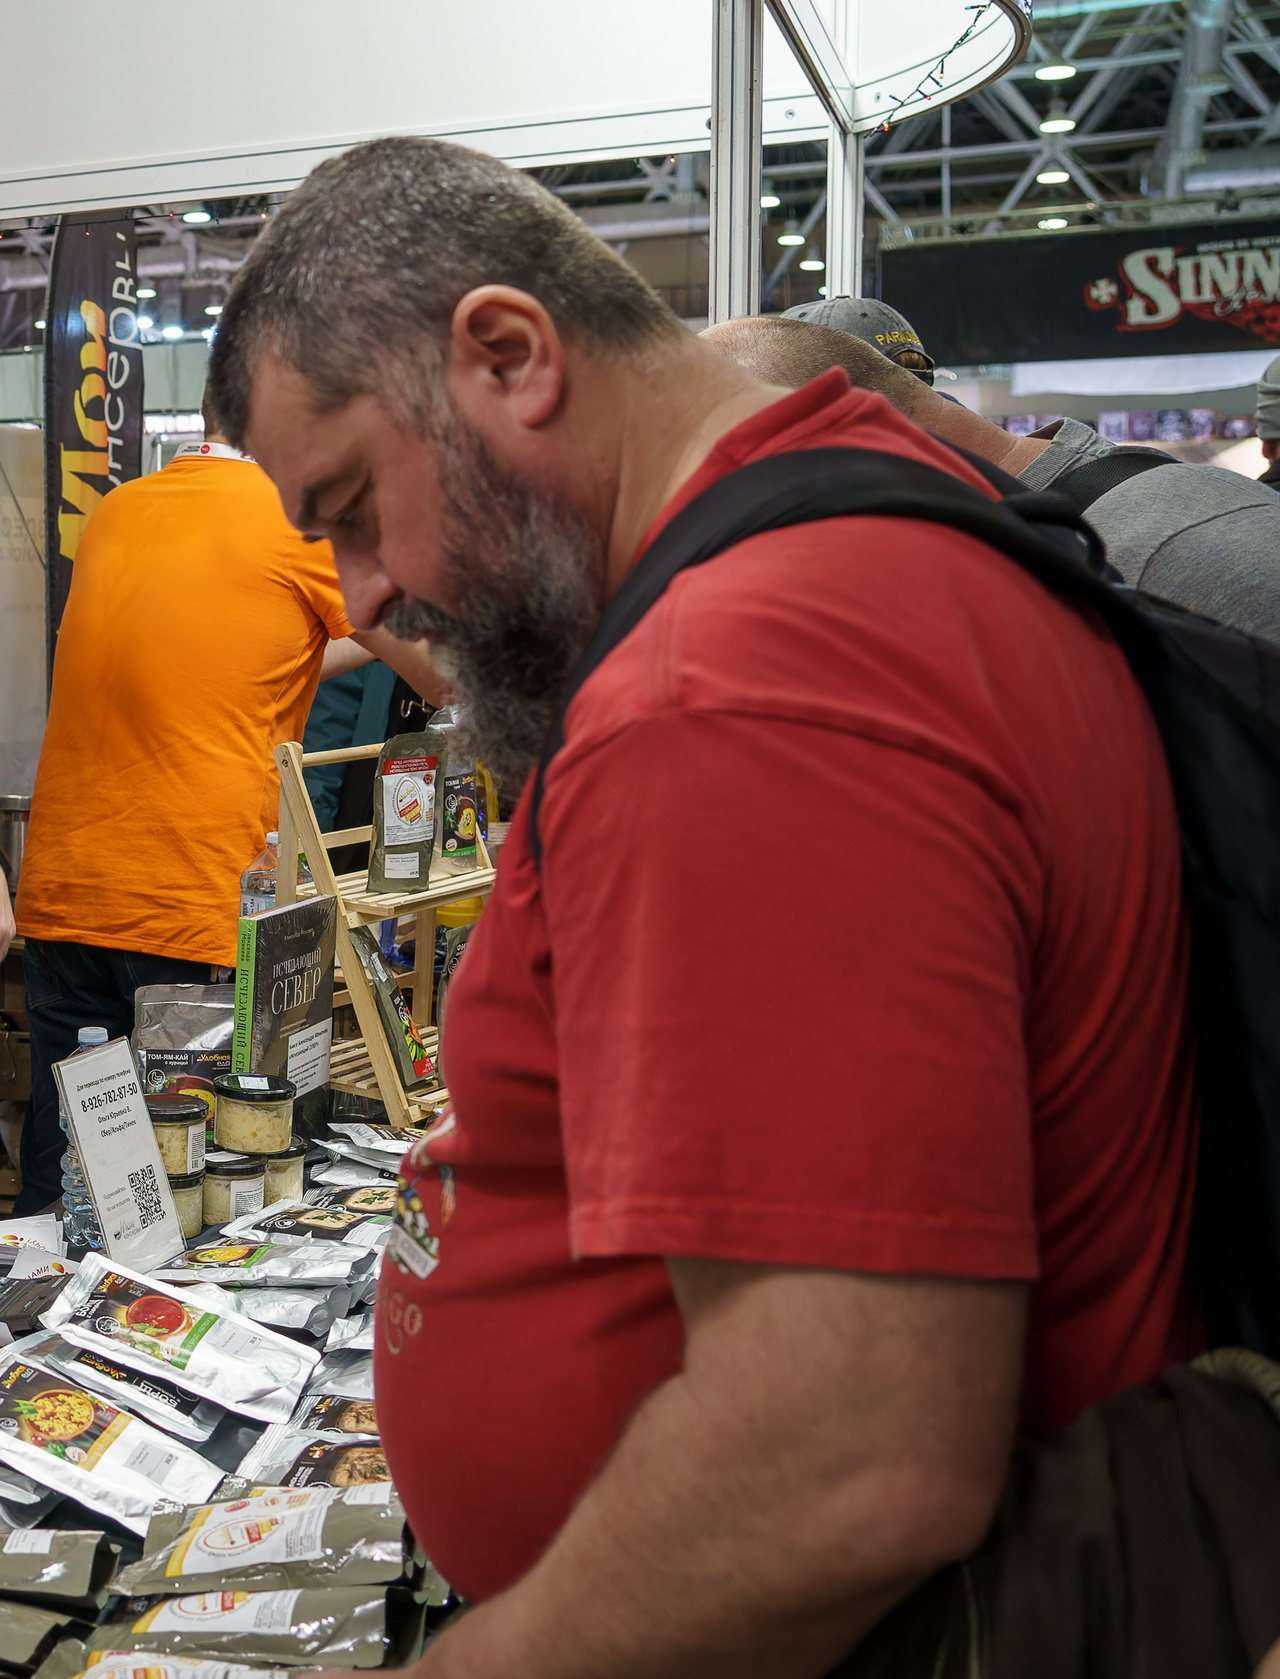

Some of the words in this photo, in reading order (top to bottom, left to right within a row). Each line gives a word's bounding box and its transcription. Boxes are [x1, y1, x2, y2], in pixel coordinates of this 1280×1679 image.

[272, 947, 322, 979] ИСЧЕЗАЮЩИЙ
[271, 966, 322, 1016] СЕВЕР
[236, 968, 249, 1048] ИСЧЕЗАЮЩИЙ
[147, 1053, 189, 1061] ТОМ-ЯМ-КАЙ
[199, 1053, 231, 1062] Удобная
[80, 1082, 138, 1113] 8-926-782-87-50
[81, 1357, 119, 1379] Удобная
[140, 1382, 178, 1408] БОРЩ
